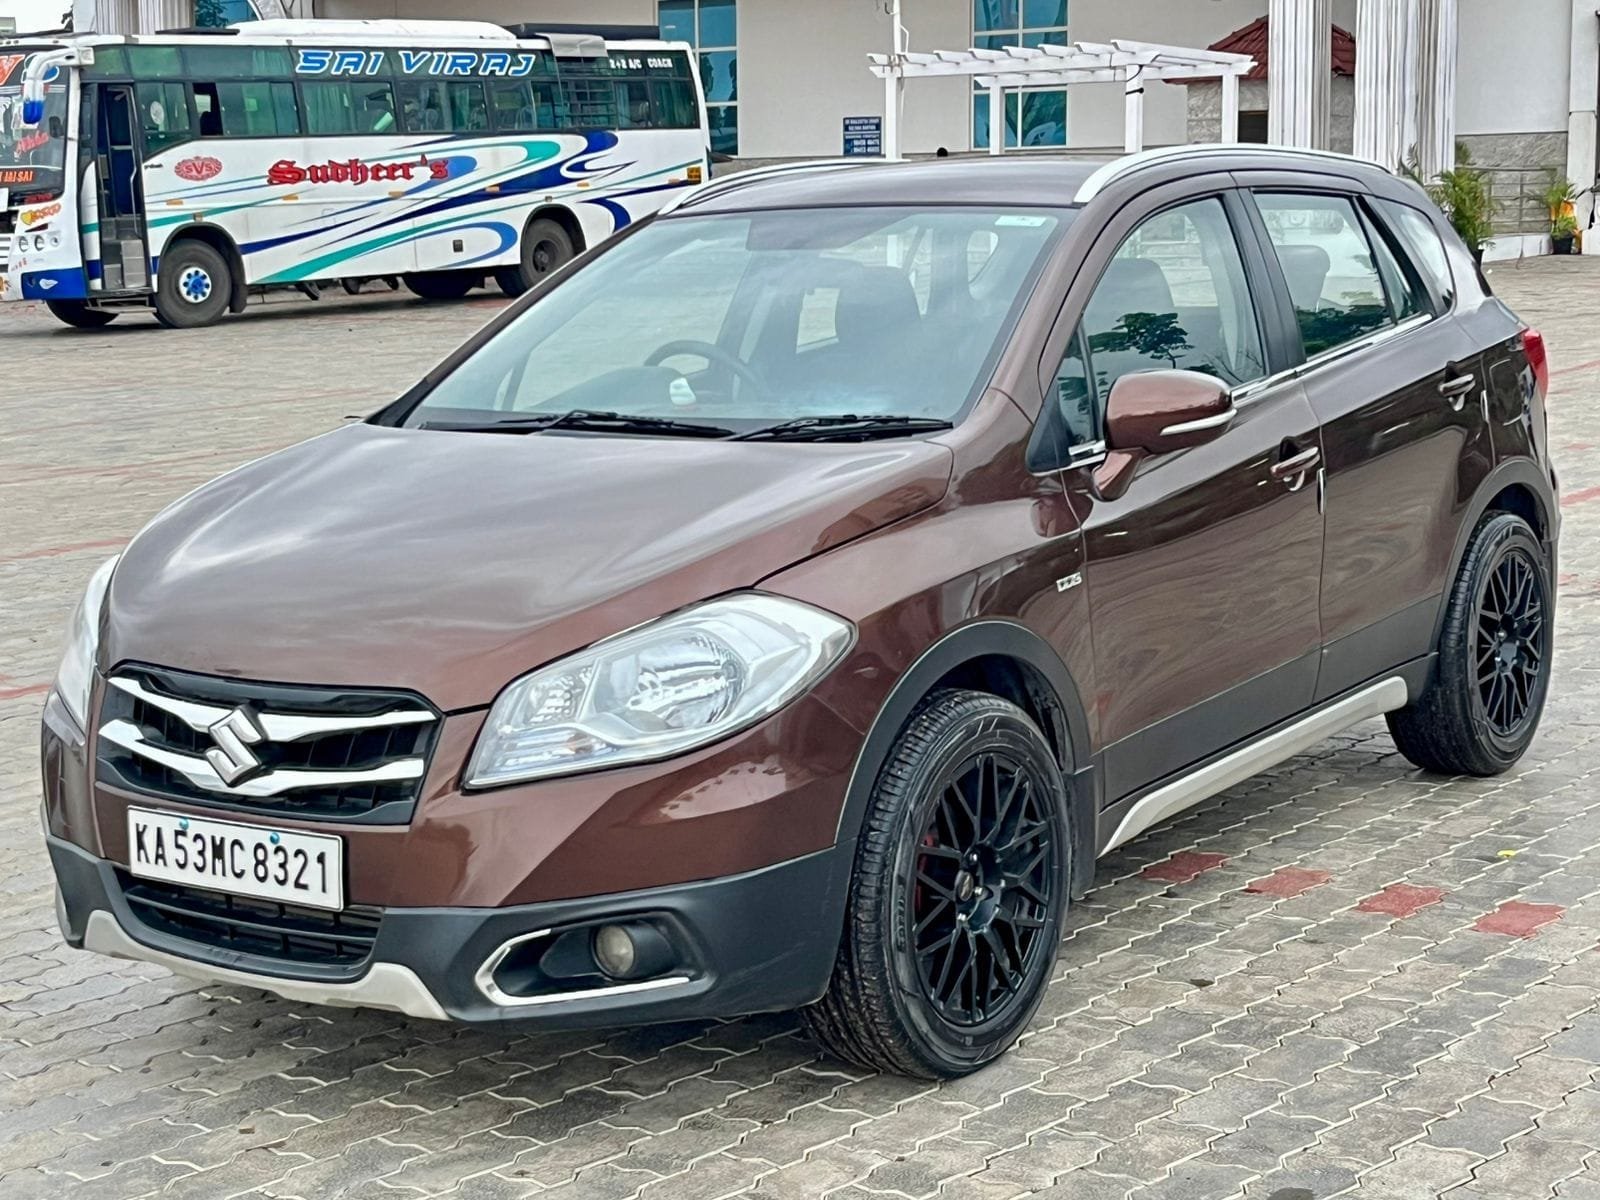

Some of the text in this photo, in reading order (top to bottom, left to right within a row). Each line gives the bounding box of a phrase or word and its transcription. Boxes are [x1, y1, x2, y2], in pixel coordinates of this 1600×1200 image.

[295, 50, 536, 77] SAI VIRAJ
[647, 57, 673, 68] COACH
[267, 153, 449, 186] Sudheer's
